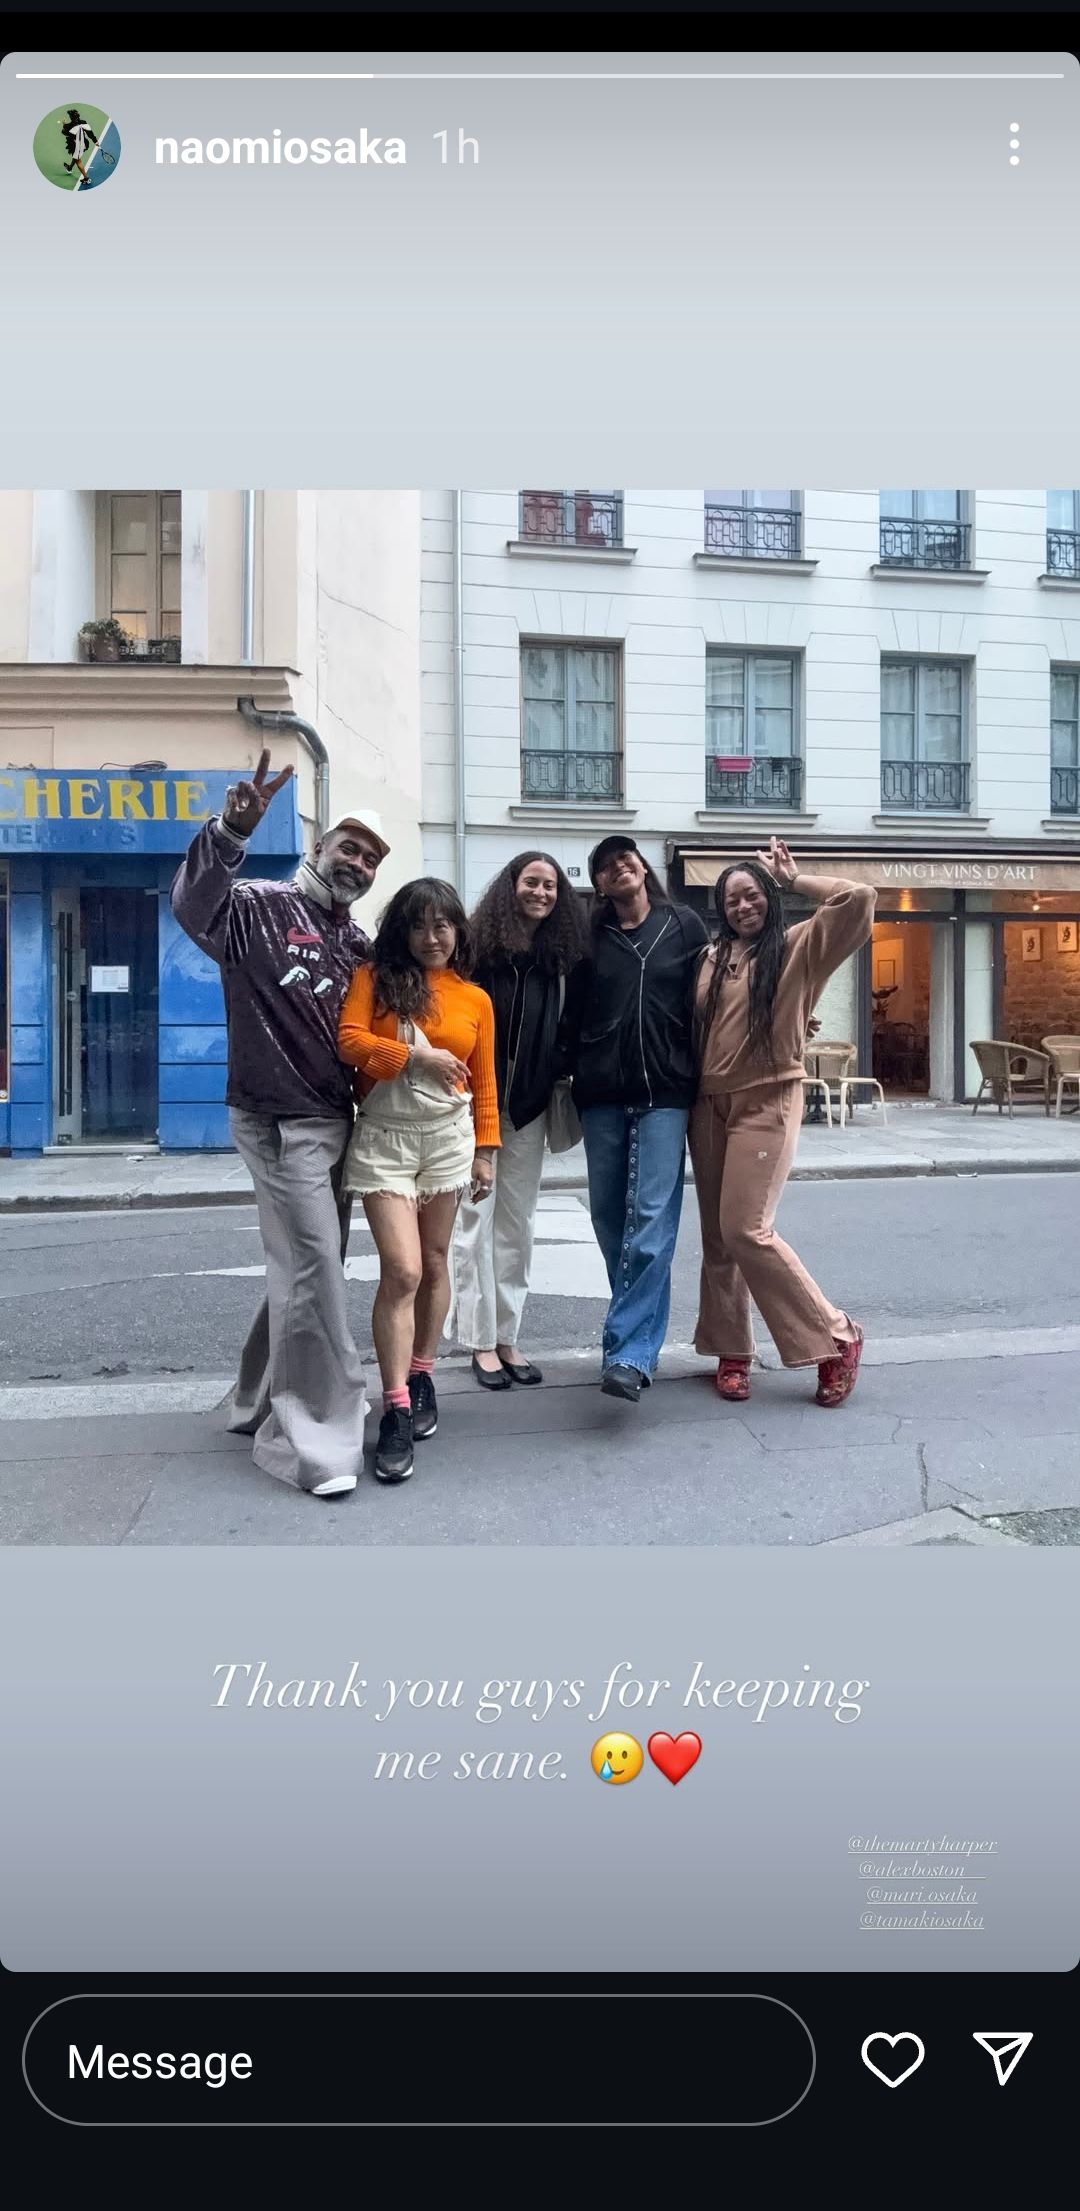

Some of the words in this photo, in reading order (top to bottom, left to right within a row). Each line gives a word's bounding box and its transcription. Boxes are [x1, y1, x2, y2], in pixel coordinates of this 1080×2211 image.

[568, 867, 580, 877] 16
[882, 863, 938, 880] VINGT
[943, 864, 982, 880] VINS
[986, 865, 1038, 881] D'ART
[286, 944, 321, 962] AIR
